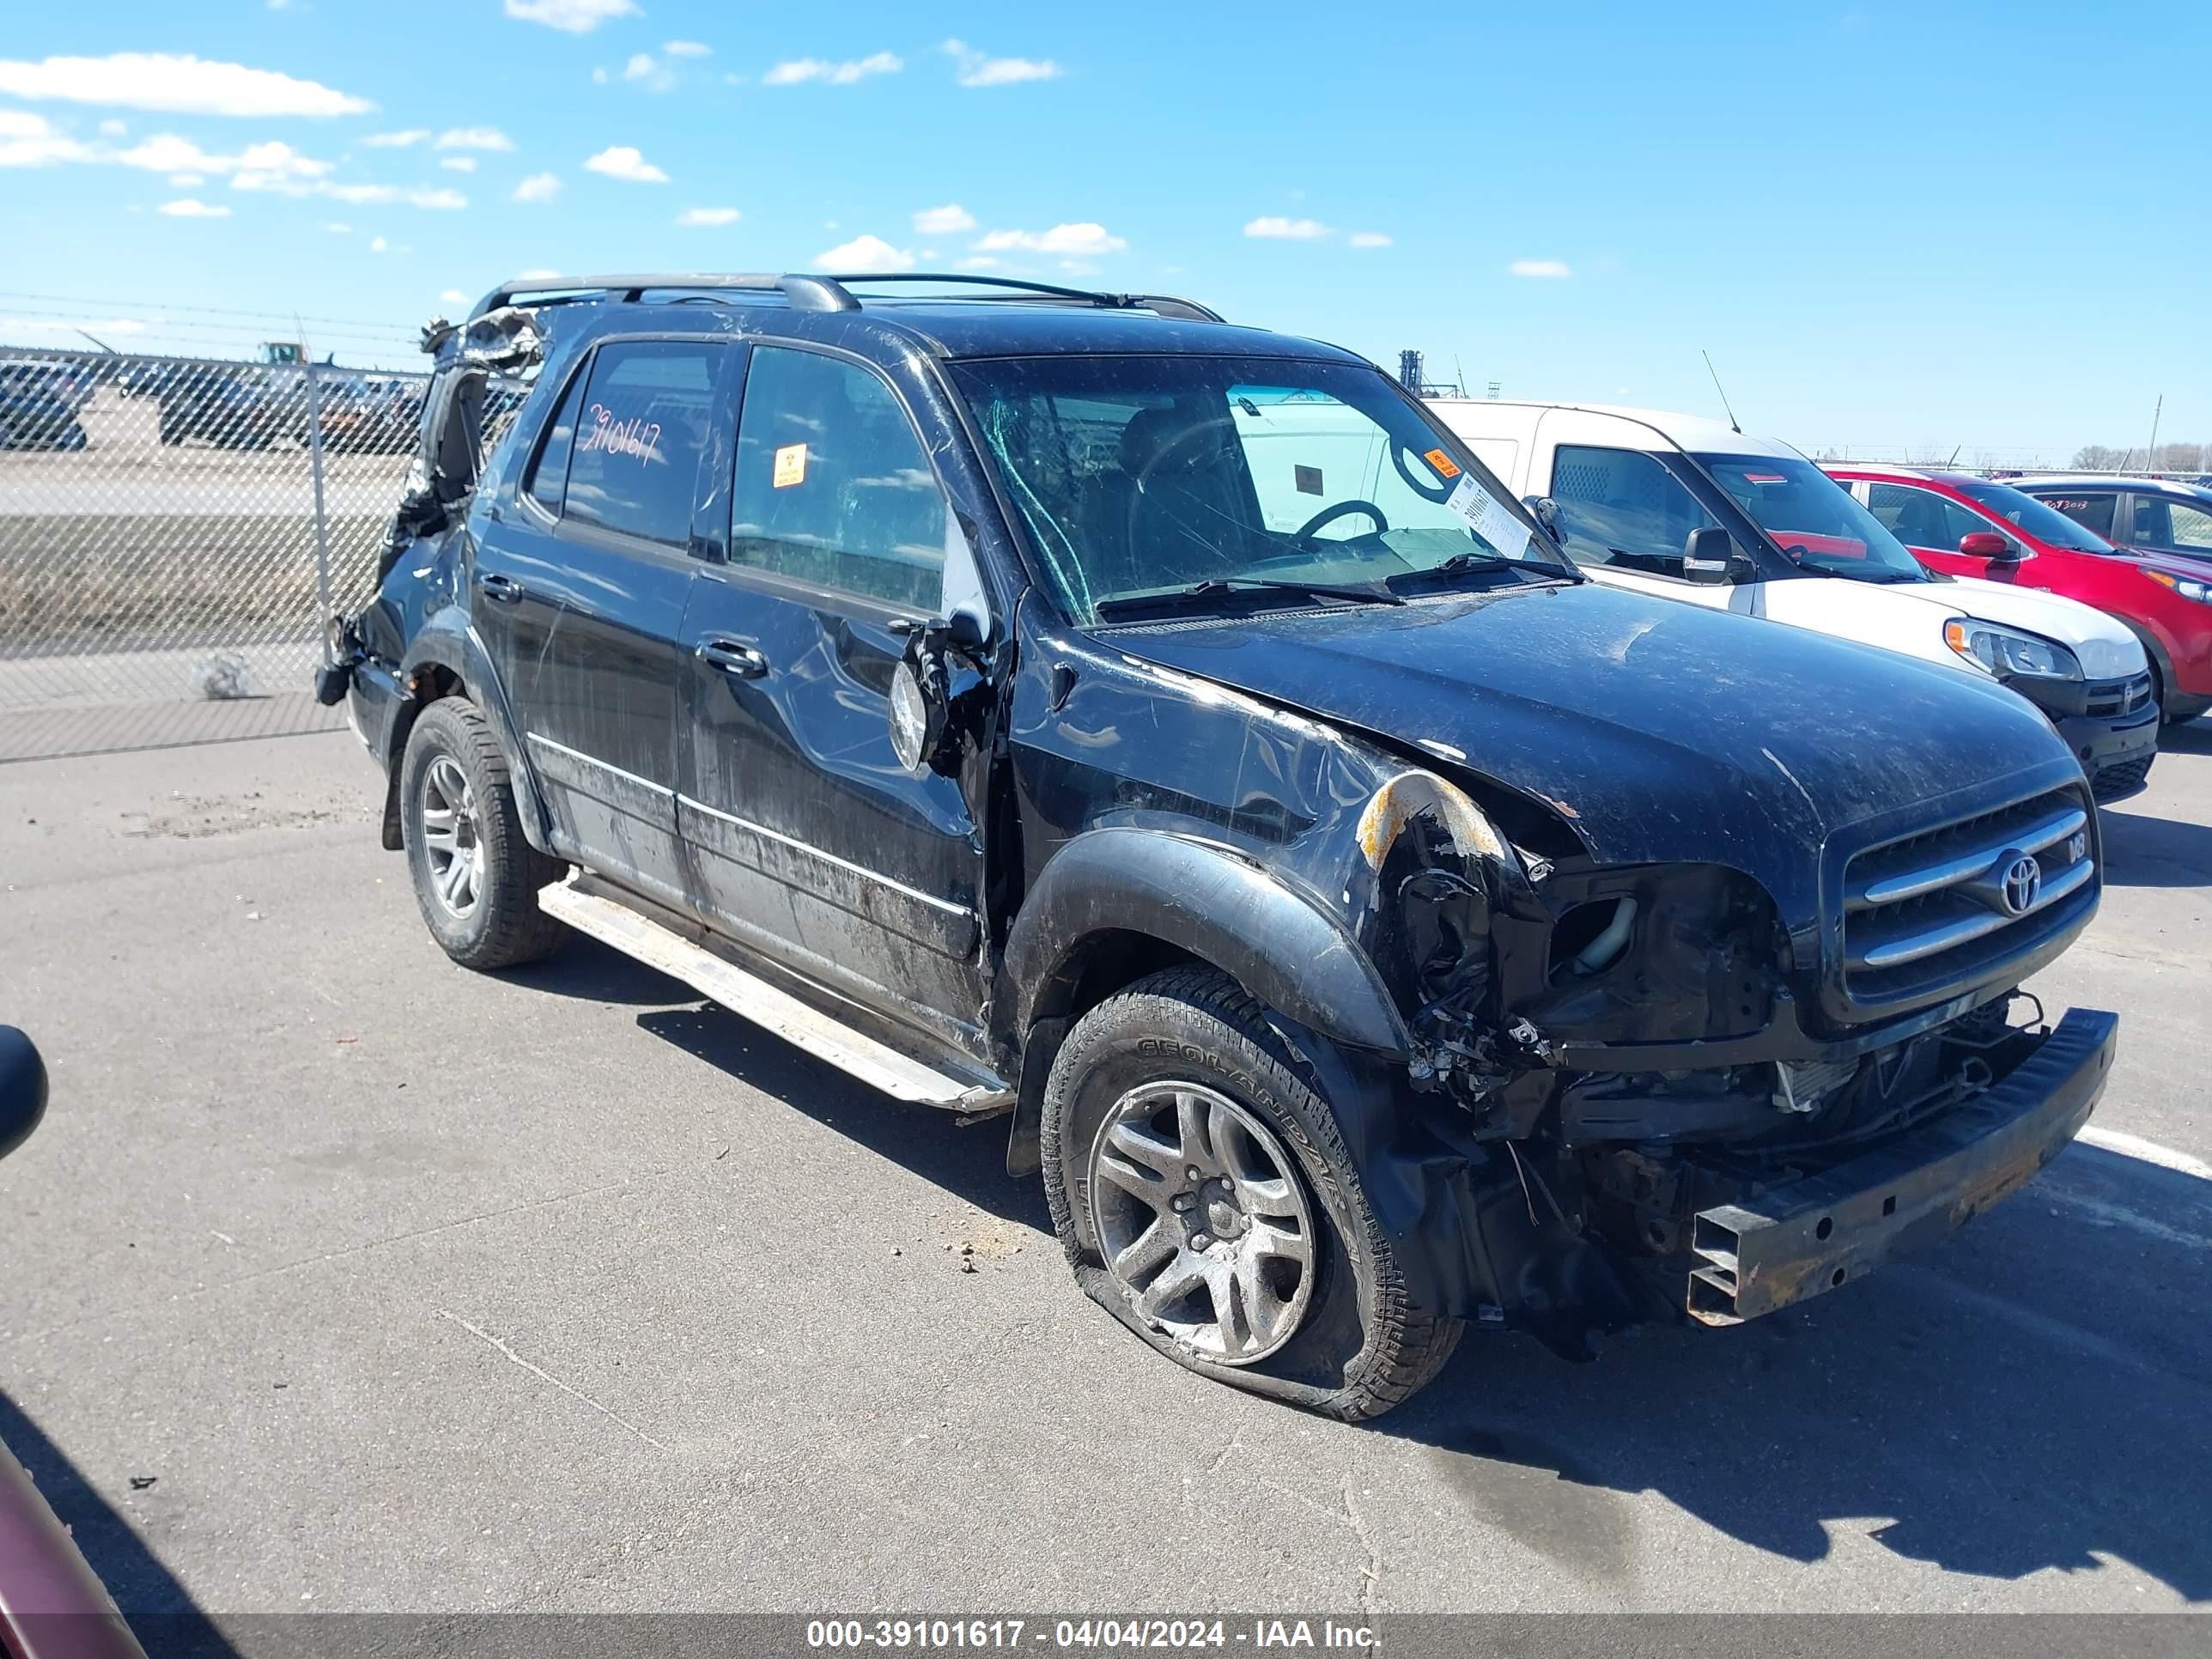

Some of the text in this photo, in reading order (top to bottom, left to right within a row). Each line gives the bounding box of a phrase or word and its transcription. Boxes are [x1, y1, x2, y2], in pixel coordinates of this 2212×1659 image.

[583, 403, 661, 468] 39101617
[1464, 489, 1491, 525] 39101617
[2069, 833, 2086, 864] V8
[1136, 1037, 1347, 1212] GEOLANDAR
